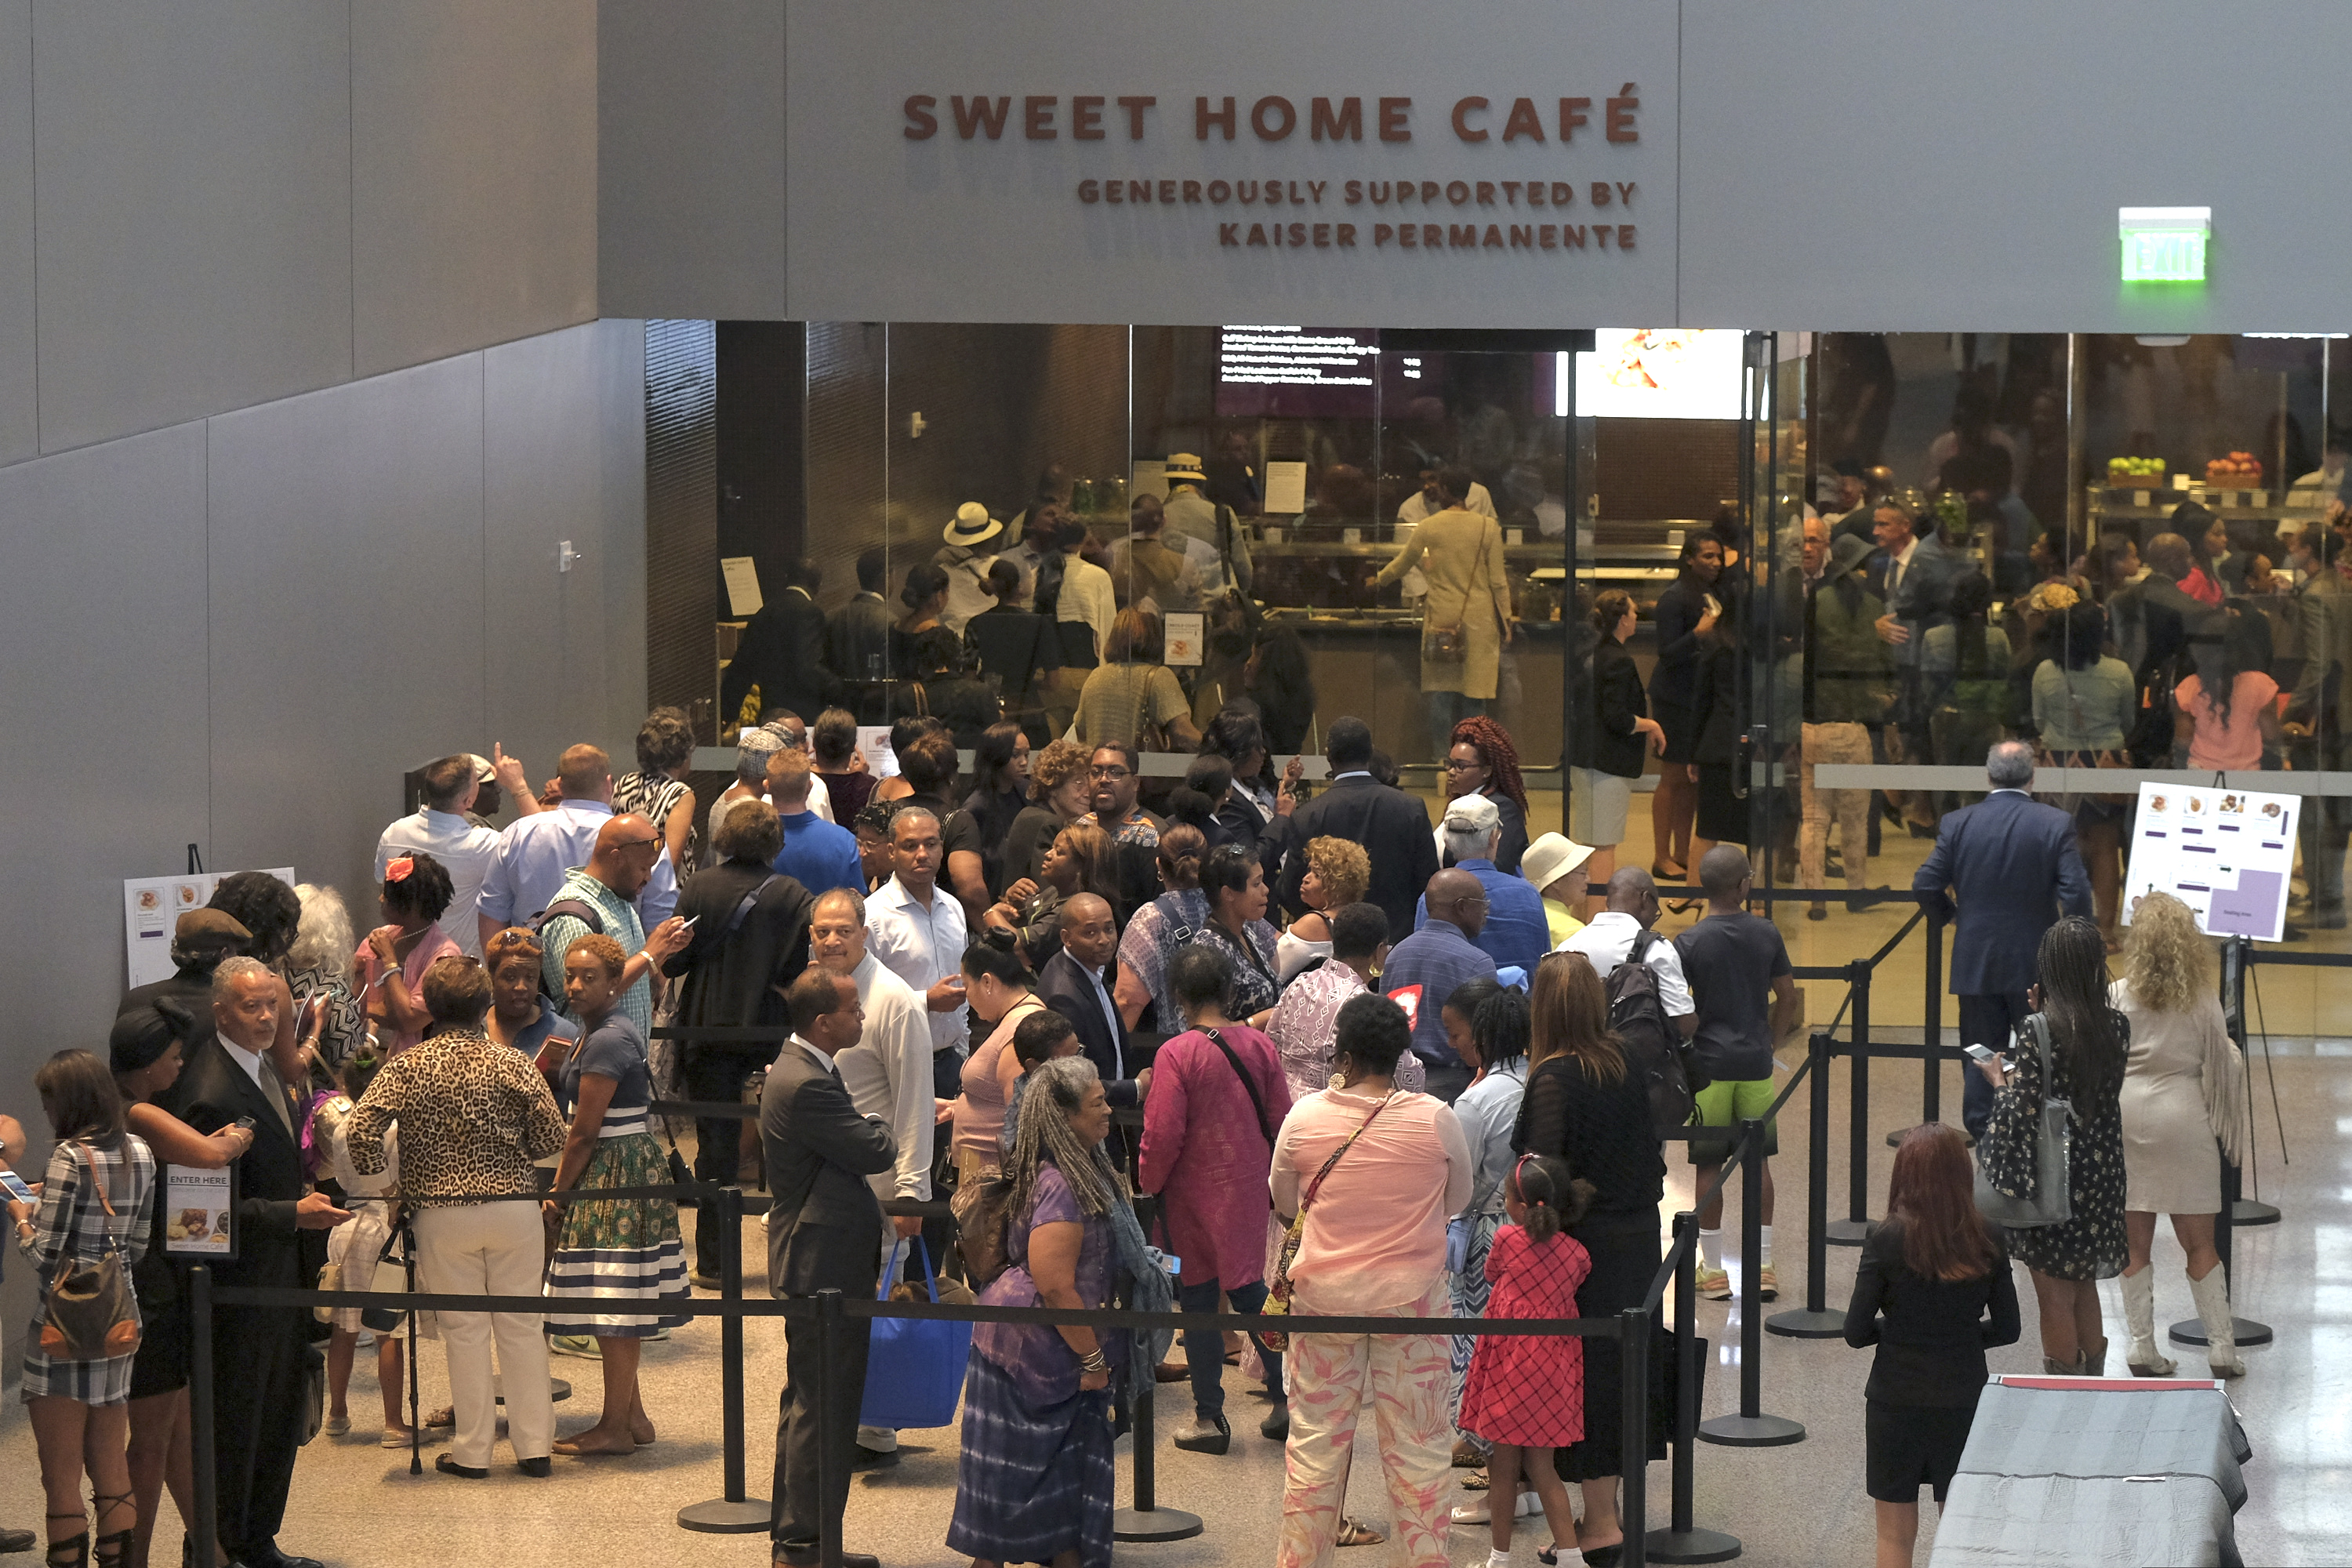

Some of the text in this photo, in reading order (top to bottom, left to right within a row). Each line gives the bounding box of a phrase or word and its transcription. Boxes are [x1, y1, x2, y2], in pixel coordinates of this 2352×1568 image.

[903, 82, 1639, 143] SWEET HOME CAFÉ
[1078, 180, 1635, 206] GENEROUSLY SUPPORTED BY
[1219, 223, 1635, 249] KAISER PERMANENTE
[2134, 232, 2198, 275] EXIT
